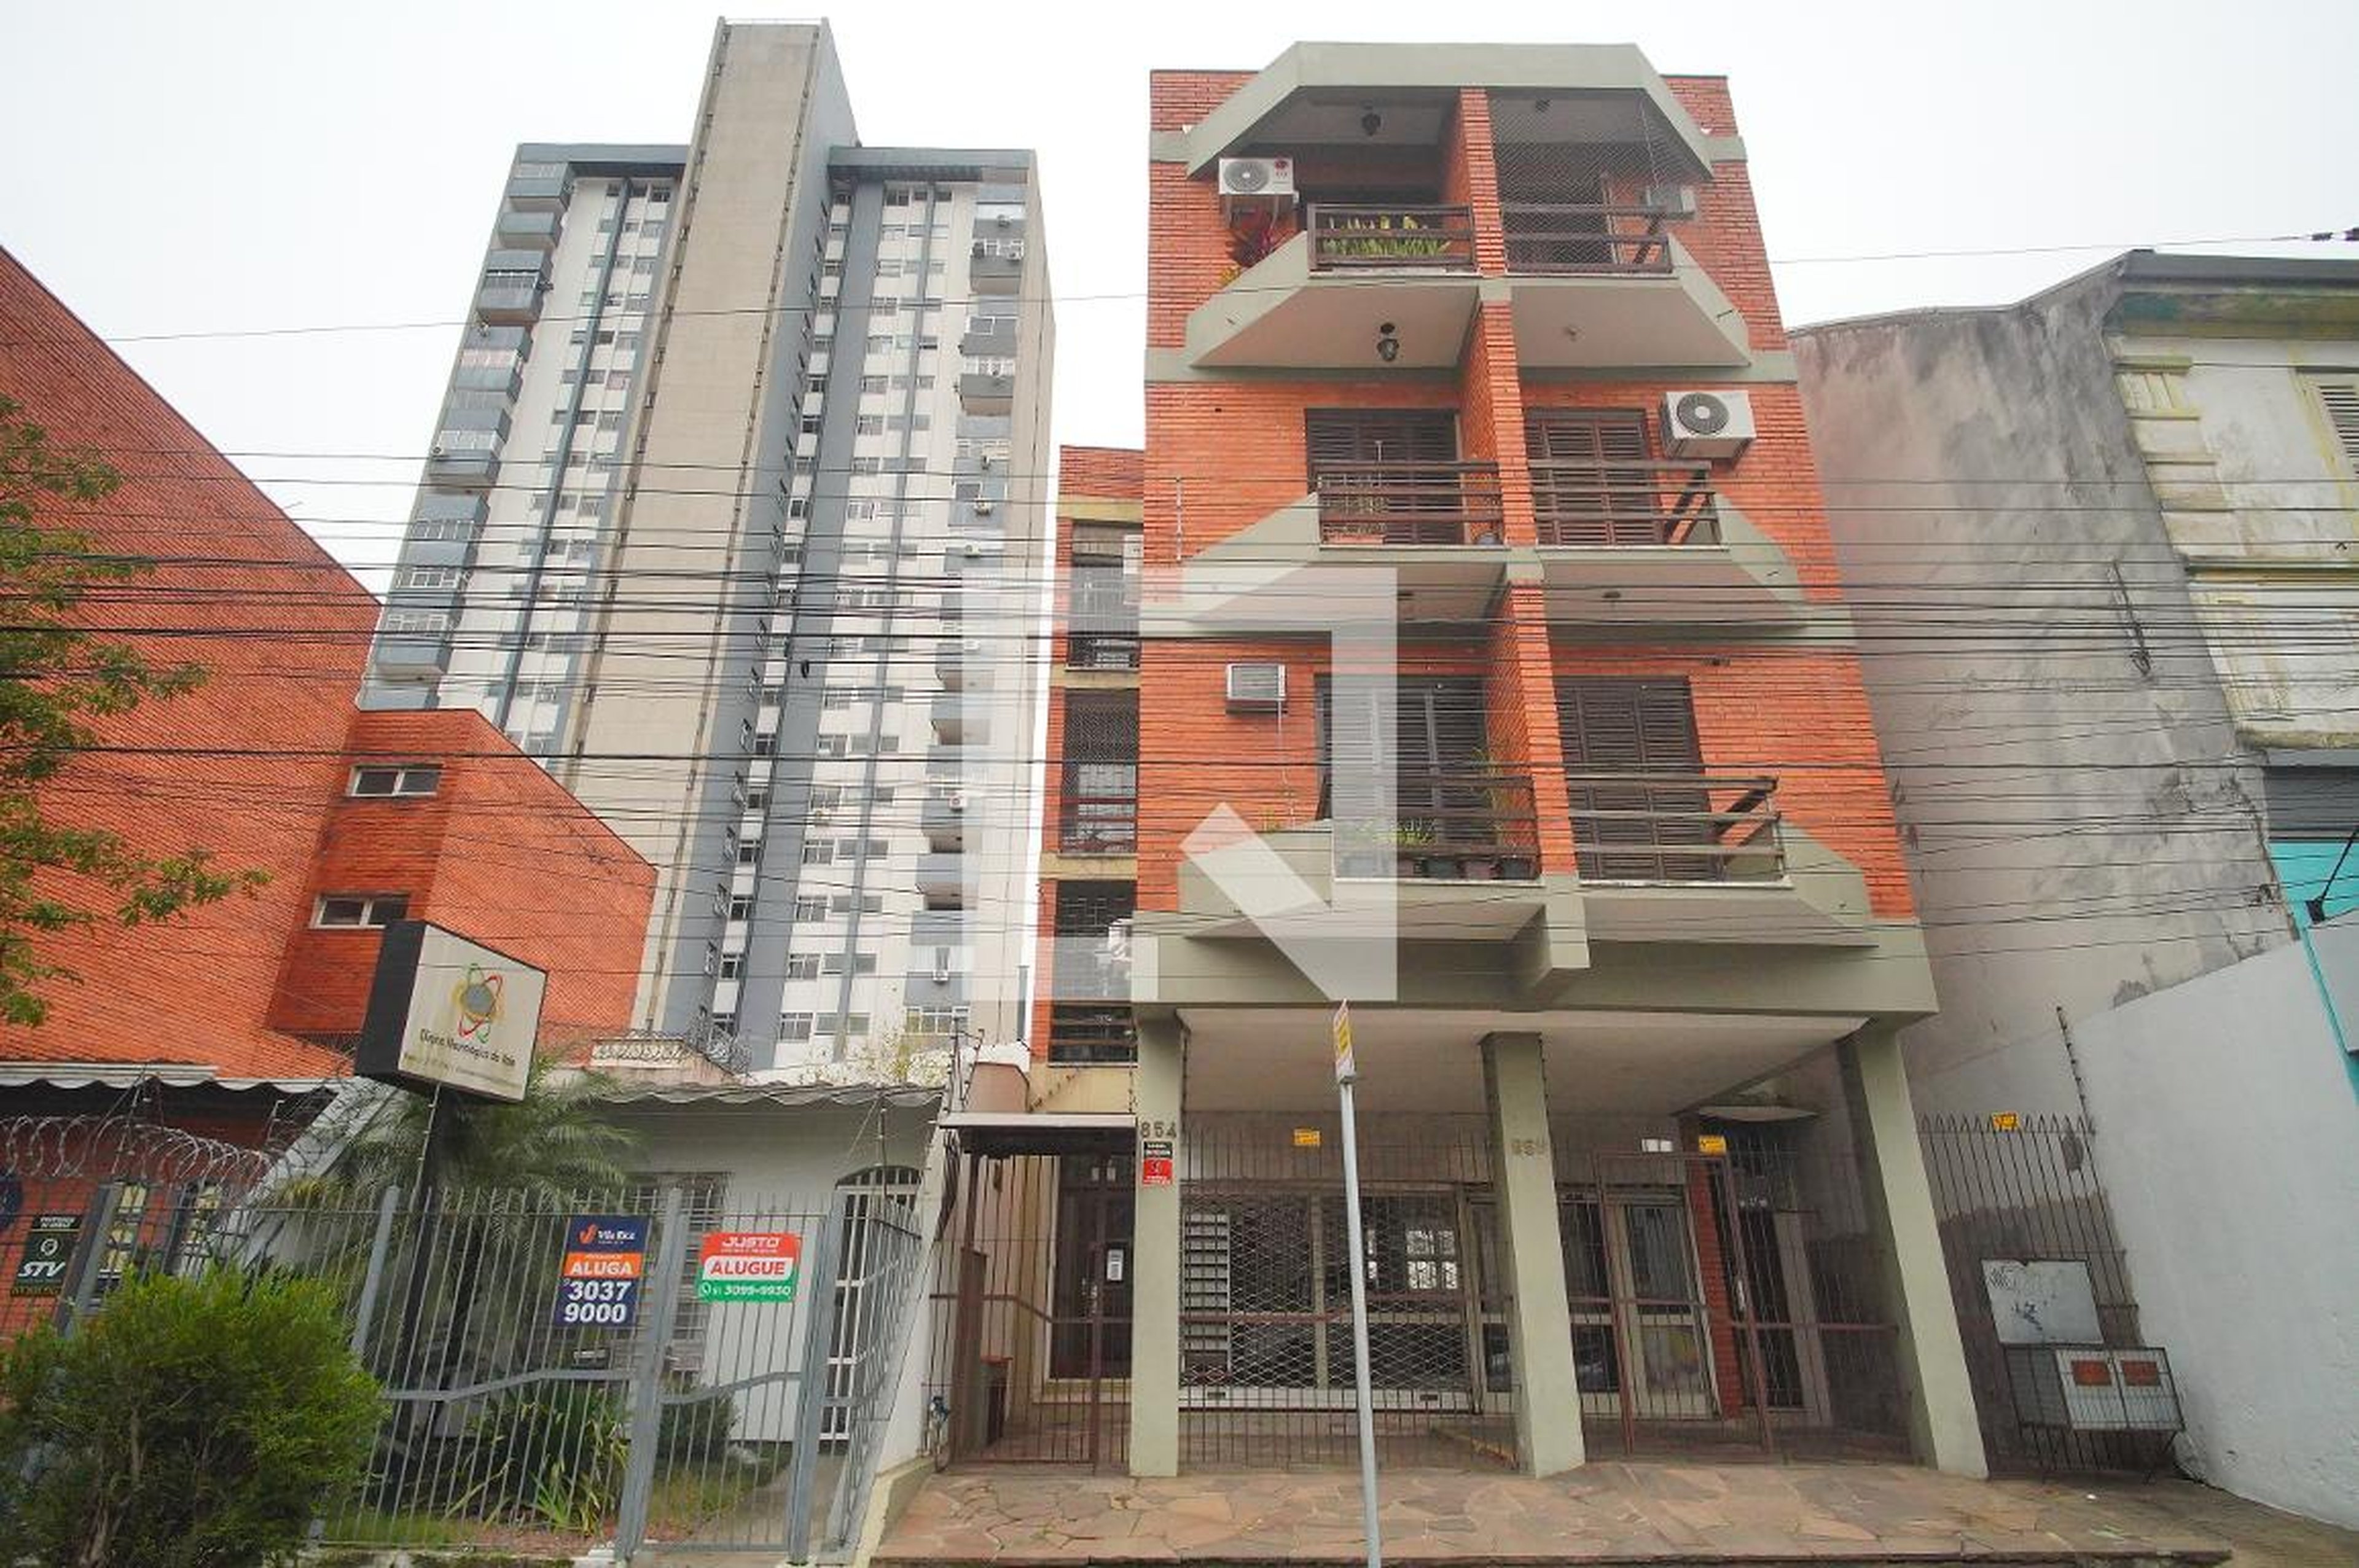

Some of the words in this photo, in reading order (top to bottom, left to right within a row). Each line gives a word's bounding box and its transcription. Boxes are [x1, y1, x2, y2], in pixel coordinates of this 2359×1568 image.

[1141, 1121, 1176, 1138] 854
[18, 1262, 66, 1277] STV
[570, 1261, 633, 1275] ALUGA
[710, 1262, 785, 1275] ALUGUE
[568, 1281, 632, 1301] 3037
[563, 1302, 627, 1322] 9000
